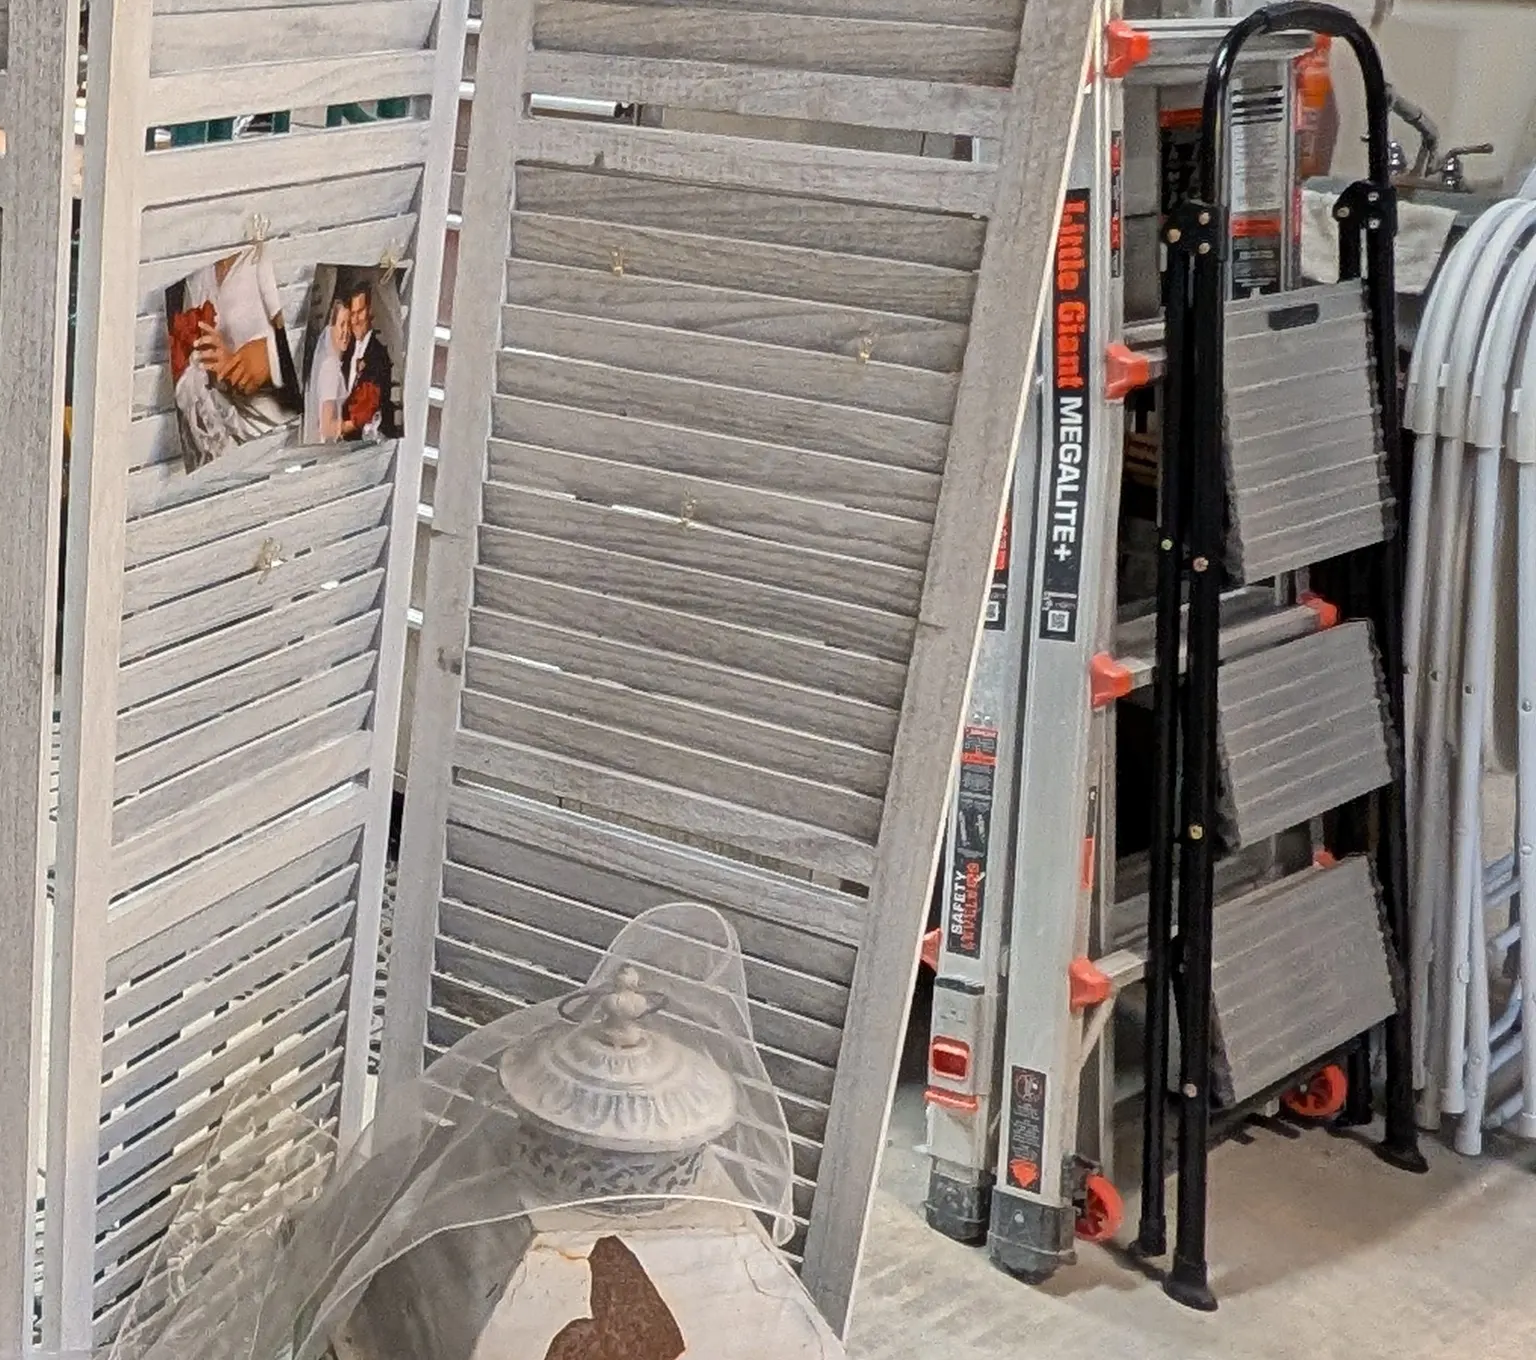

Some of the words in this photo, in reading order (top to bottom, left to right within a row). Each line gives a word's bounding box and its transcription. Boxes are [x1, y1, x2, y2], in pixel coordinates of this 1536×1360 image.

[1058, 200, 1088, 291] Little
[1056, 301, 1087, 389] Giant
[1052, 396, 1083, 562] MEGALITE+
[951, 869, 967, 935] SAFETY
